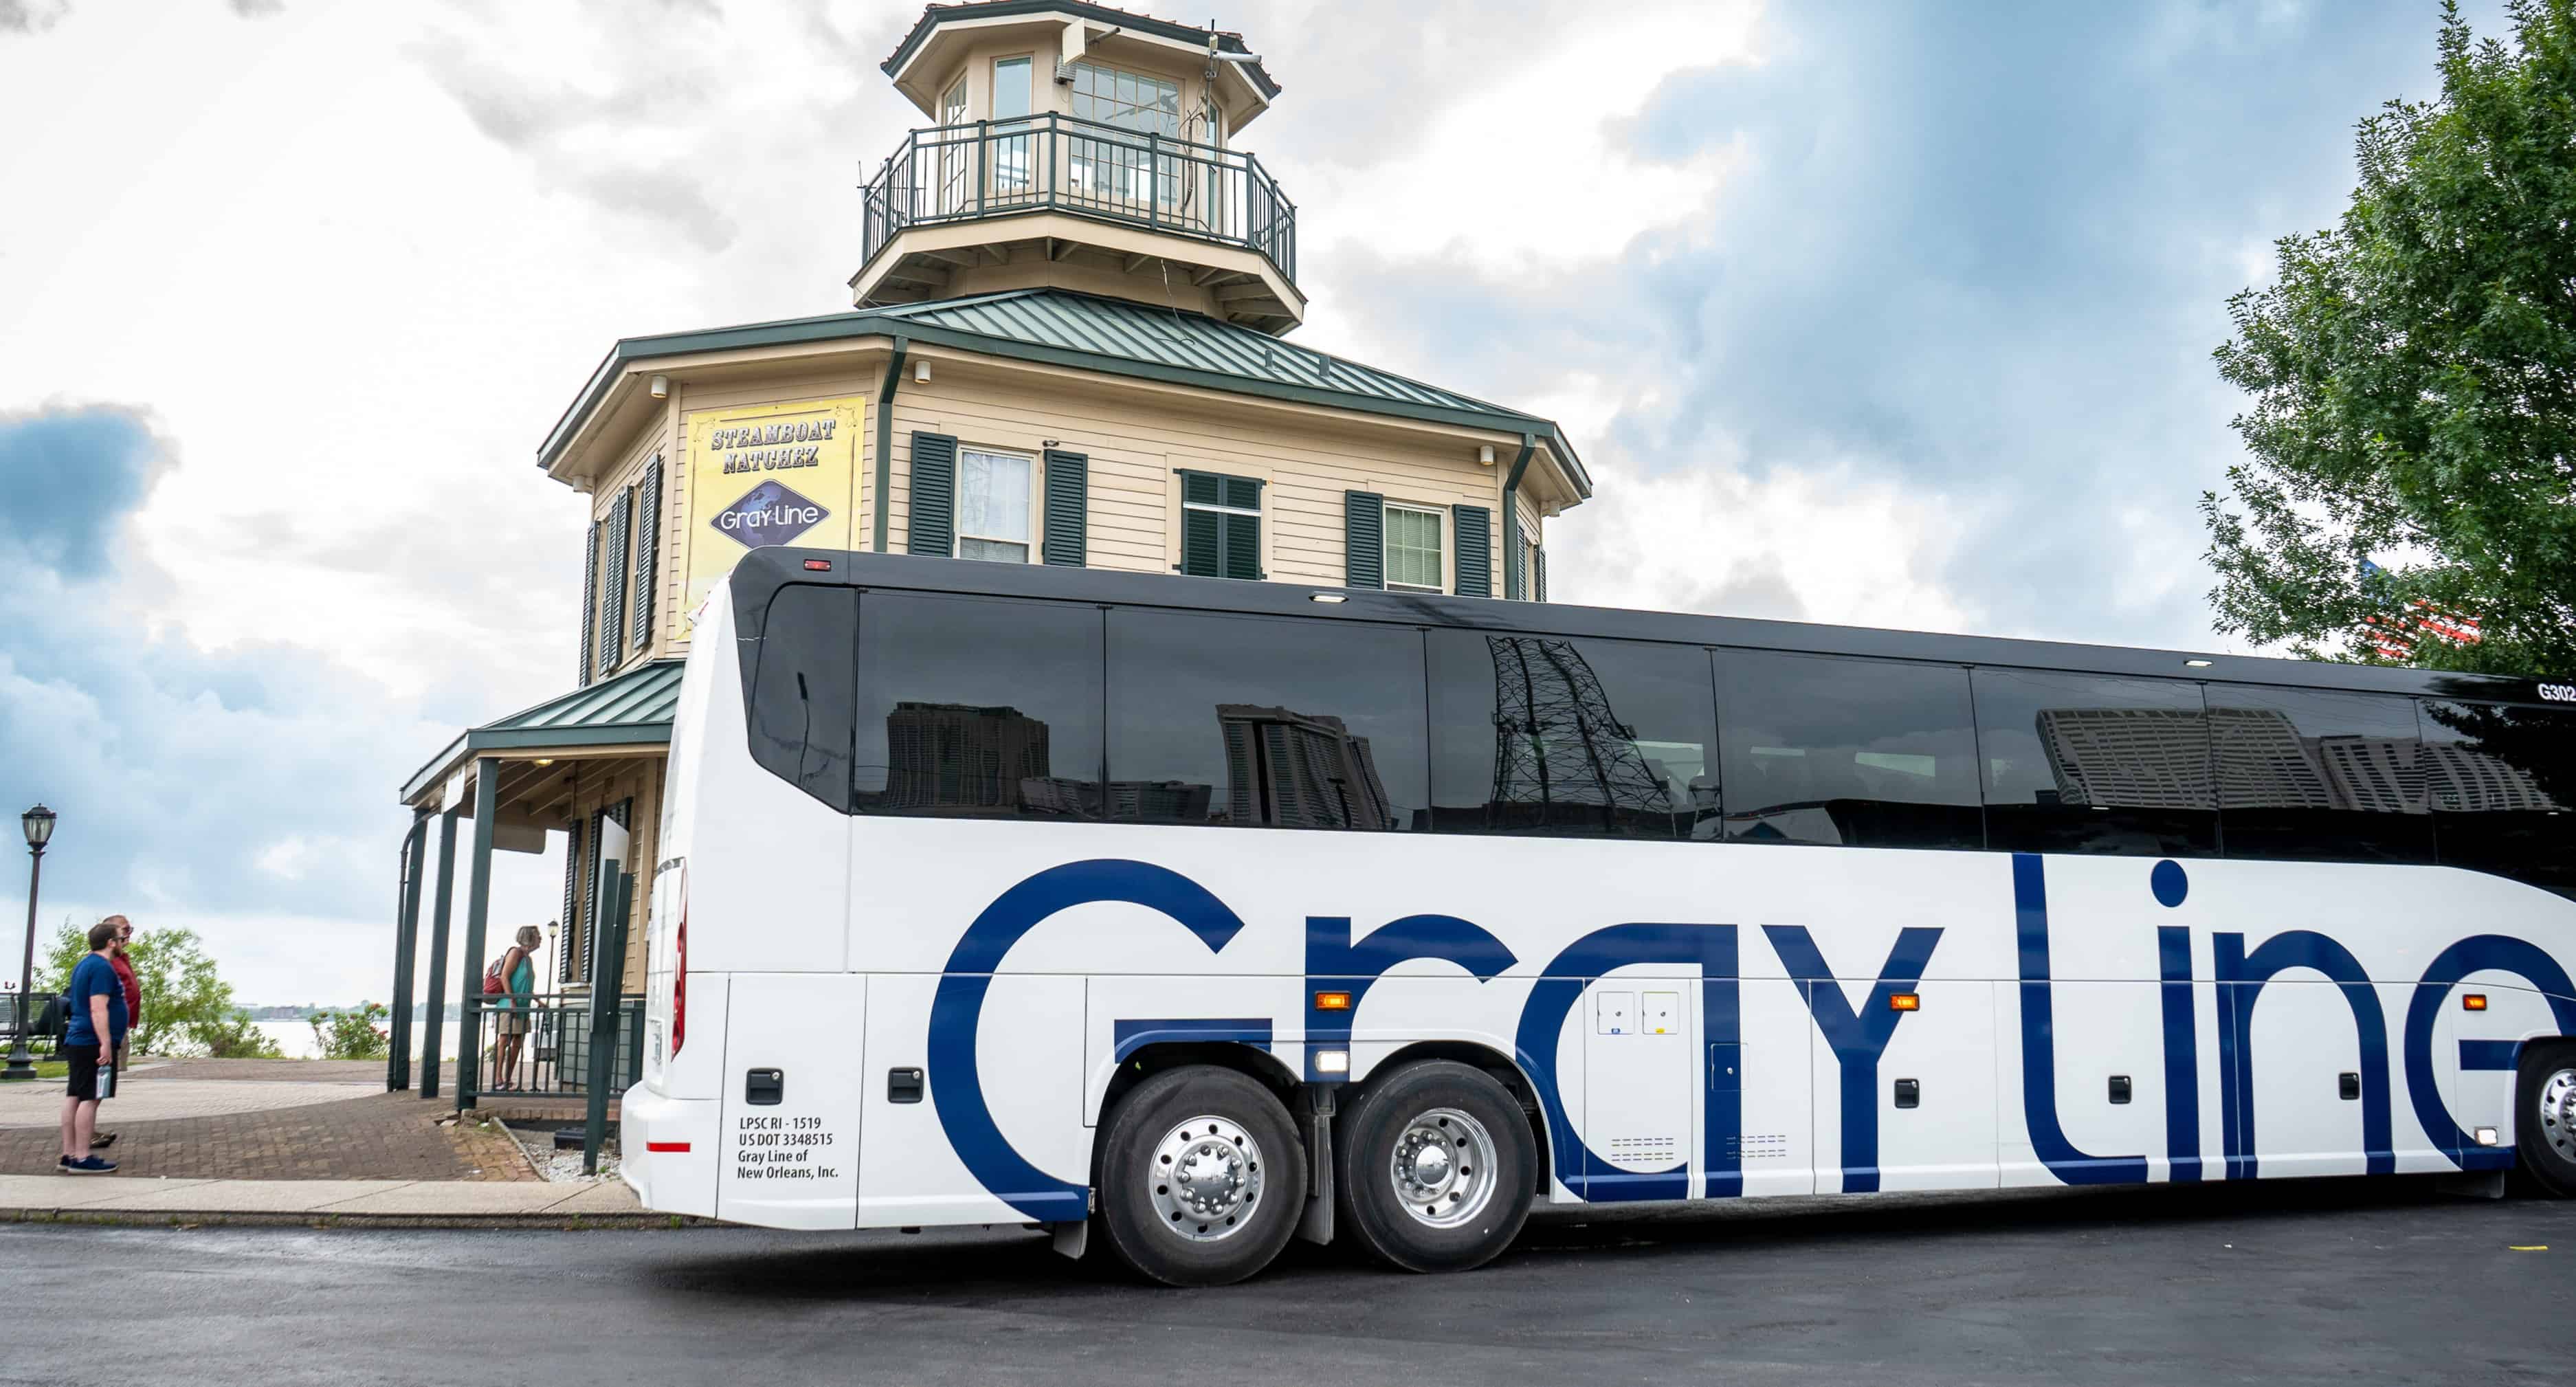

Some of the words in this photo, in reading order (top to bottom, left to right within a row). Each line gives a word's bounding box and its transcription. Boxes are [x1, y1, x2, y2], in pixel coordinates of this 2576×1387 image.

[711, 419, 836, 450] STEAMBOAT
[722, 445, 819, 474] NATCHEZ
[720, 509, 773, 529] Gray
[775, 505, 819, 526] Line
[928, 858, 1945, 1221] Gray
[2012, 852, 2576, 1186] Line
[740, 1117, 768, 1129] LPSC
[770, 1117, 782, 1129] RI
[792, 1117, 821, 1129] 1519
[757, 1133, 780, 1146] DOT
[783, 1133, 833, 1146] 3348515
[737, 1149, 765, 1166] Gray
[768, 1149, 792, 1162] Line
[795, 1149, 809, 1162] of
[737, 1166, 764, 1179] New
[766, 1166, 814, 1180] Orleans,
[817, 1165, 839, 1177] Inc.
